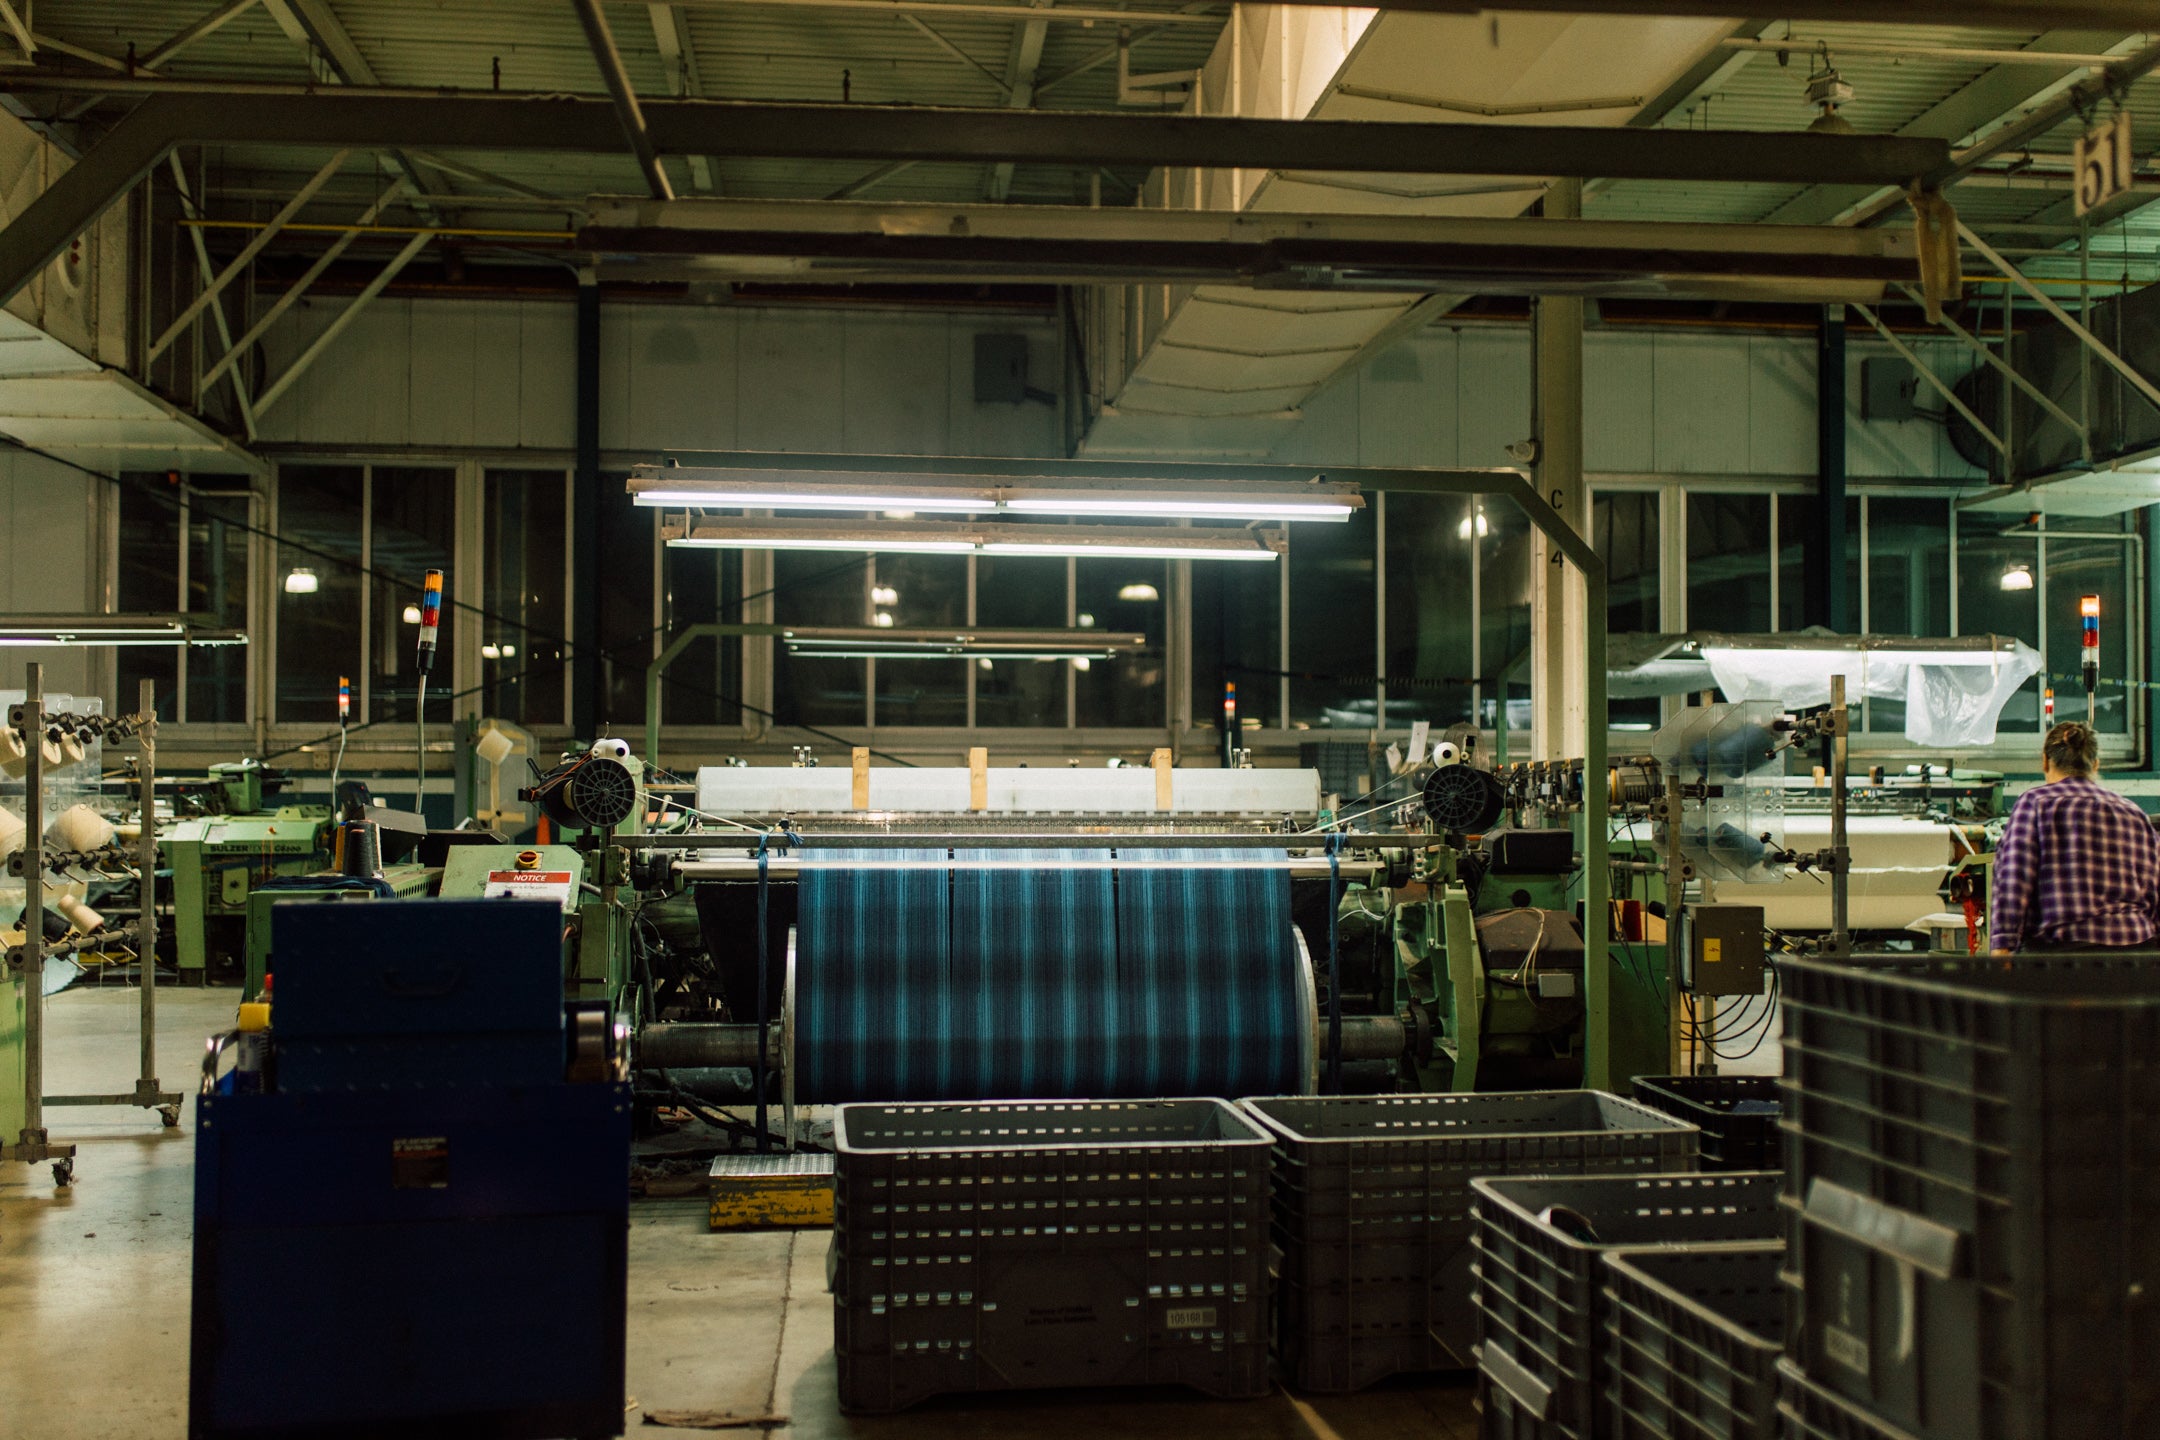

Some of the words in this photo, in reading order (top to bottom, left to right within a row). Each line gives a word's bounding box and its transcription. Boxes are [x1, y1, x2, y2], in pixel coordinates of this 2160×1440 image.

[2082, 132, 2122, 209] 51
[1551, 489, 1563, 510] C
[1551, 550, 1563, 568] 4
[513, 874, 547, 882] NOTICE
